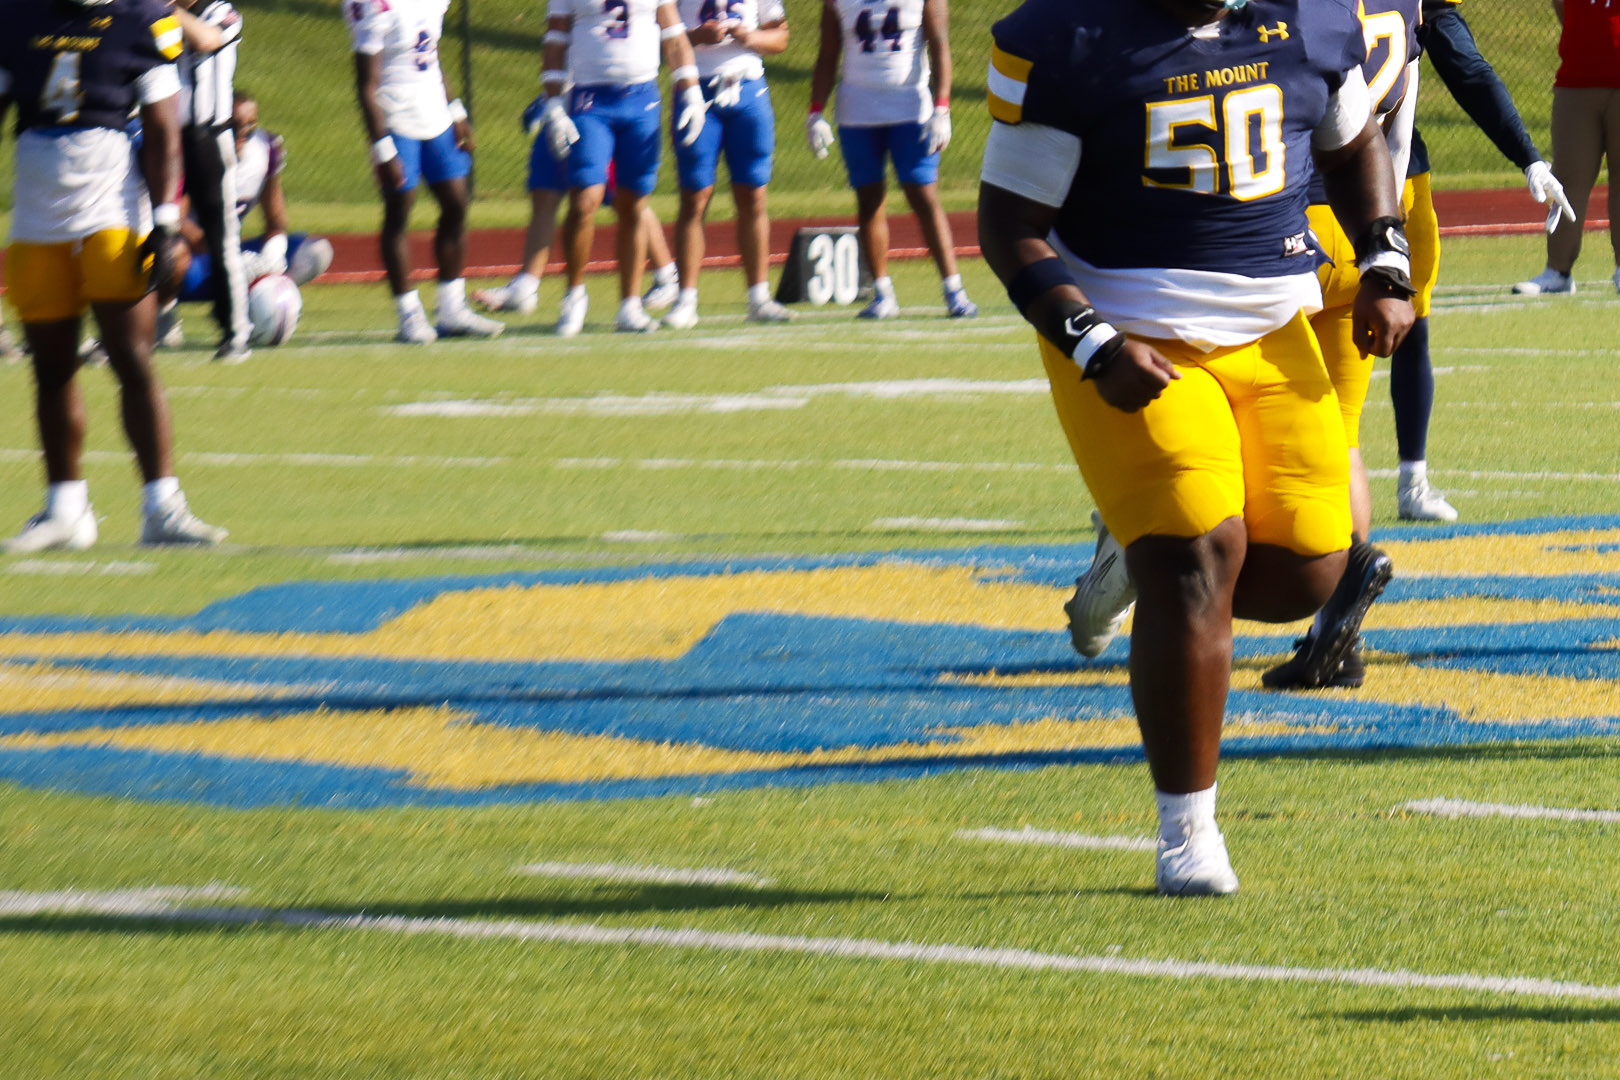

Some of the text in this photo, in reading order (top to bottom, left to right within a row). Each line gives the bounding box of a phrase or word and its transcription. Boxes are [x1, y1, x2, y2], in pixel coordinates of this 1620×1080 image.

[855, 8, 903, 53] 44
[41, 51, 86, 123] 4
[1163, 61, 1270, 94] THE MOUNT
[1141, 83, 1287, 202] 50
[807, 233, 859, 307] 30
